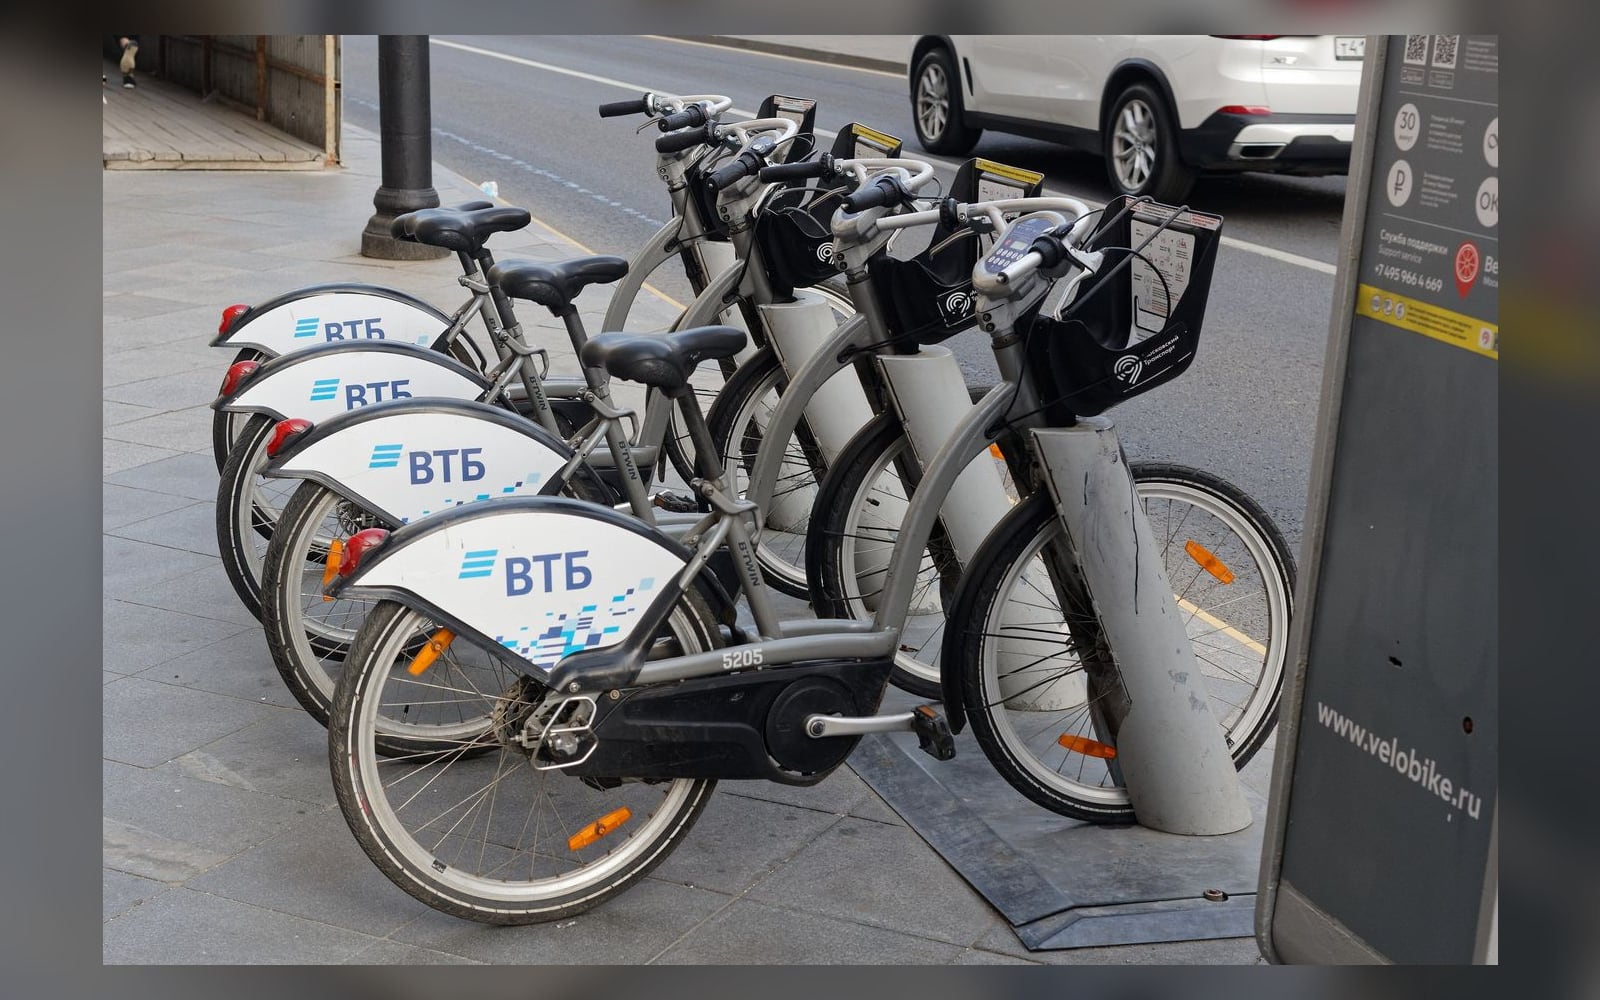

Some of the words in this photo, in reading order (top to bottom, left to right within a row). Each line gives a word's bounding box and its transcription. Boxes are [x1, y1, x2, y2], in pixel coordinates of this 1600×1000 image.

[1400, 111, 1416, 130] 30
[1378, 244, 1401, 259] Support
[1402, 251, 1422, 264] service
[1380, 228, 1406, 246] Служба
[1407, 238, 1448, 255] поддержки
[1374, 263, 1383, 276] +7
[1383, 265, 1400, 281] 495
[1401, 270, 1417, 286] 966
[1418, 274, 1424, 288] 4
[1425, 277, 1443, 293] 669
[324, 317, 385, 342] ВТБ
[1143, 344, 1176, 366] Транспорт
[345, 379, 412, 411] ВТБ
[408, 447, 486, 485] ВТБ
[504, 550, 593, 597] ВТБ
[722, 648, 764, 670] 5205
[1318, 702, 1481, 820] www.velobike.ru
